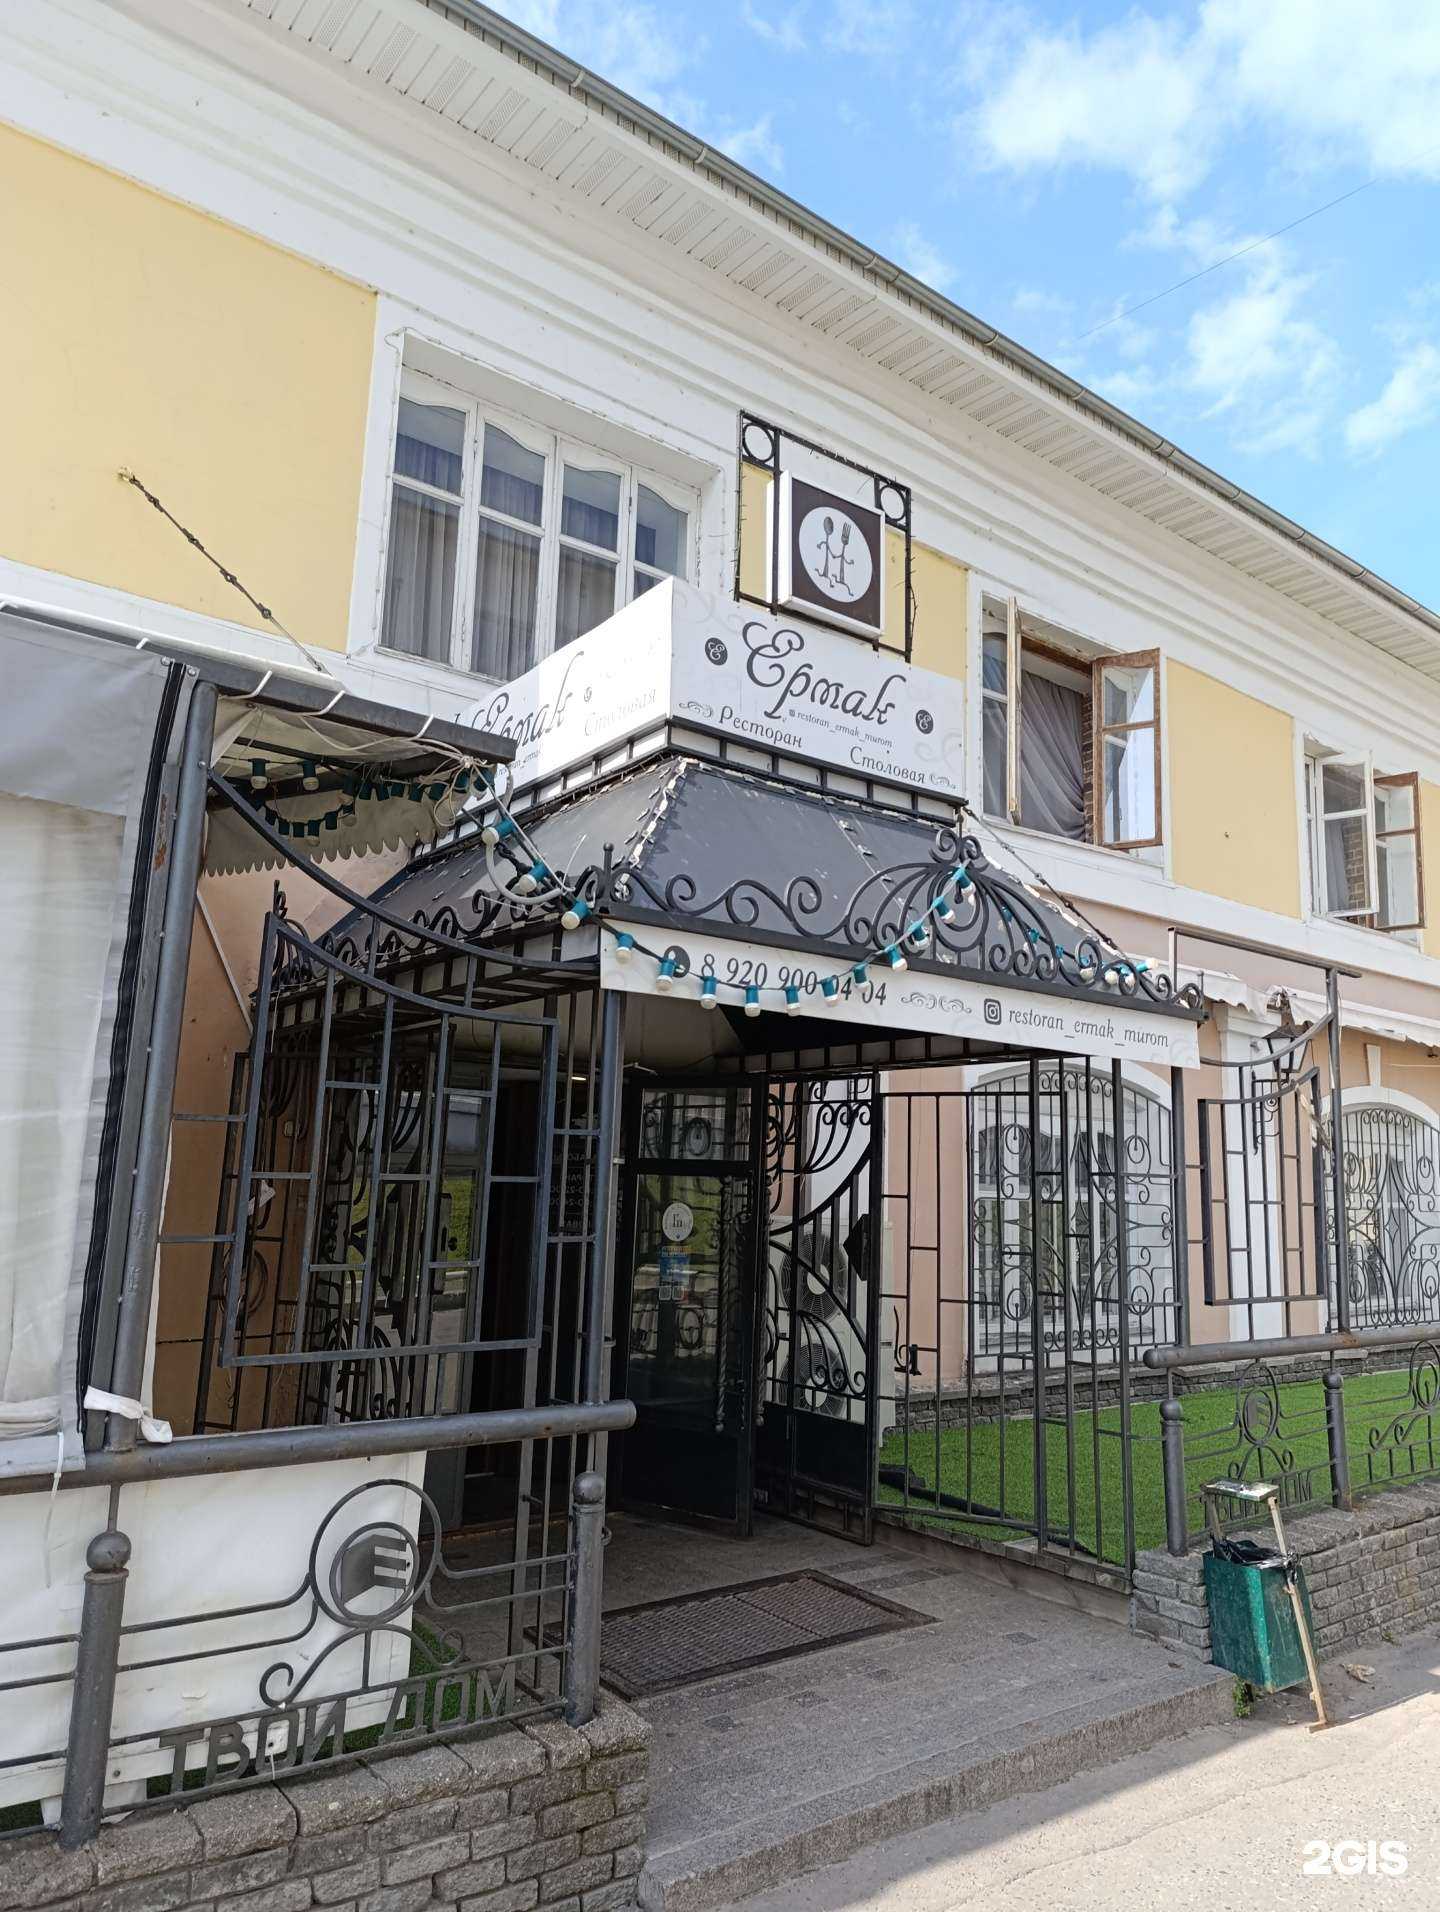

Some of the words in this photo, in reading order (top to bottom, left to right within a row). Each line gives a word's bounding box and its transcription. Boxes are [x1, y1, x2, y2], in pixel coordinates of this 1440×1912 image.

[741, 621, 907, 725] Ермак
[718, 705, 802, 748] Ресторан
[797, 702, 893, 748] restoran_ermak_murom
[850, 745, 926, 784] Столовая
[701, 953, 716, 979] 8
[726, 957, 768, 989] 920
[778, 966, 817, 995] 900
[1008, 998, 1169, 1048] restoran_ermak_murom
[378, 1662, 516, 1747] ДОМ
